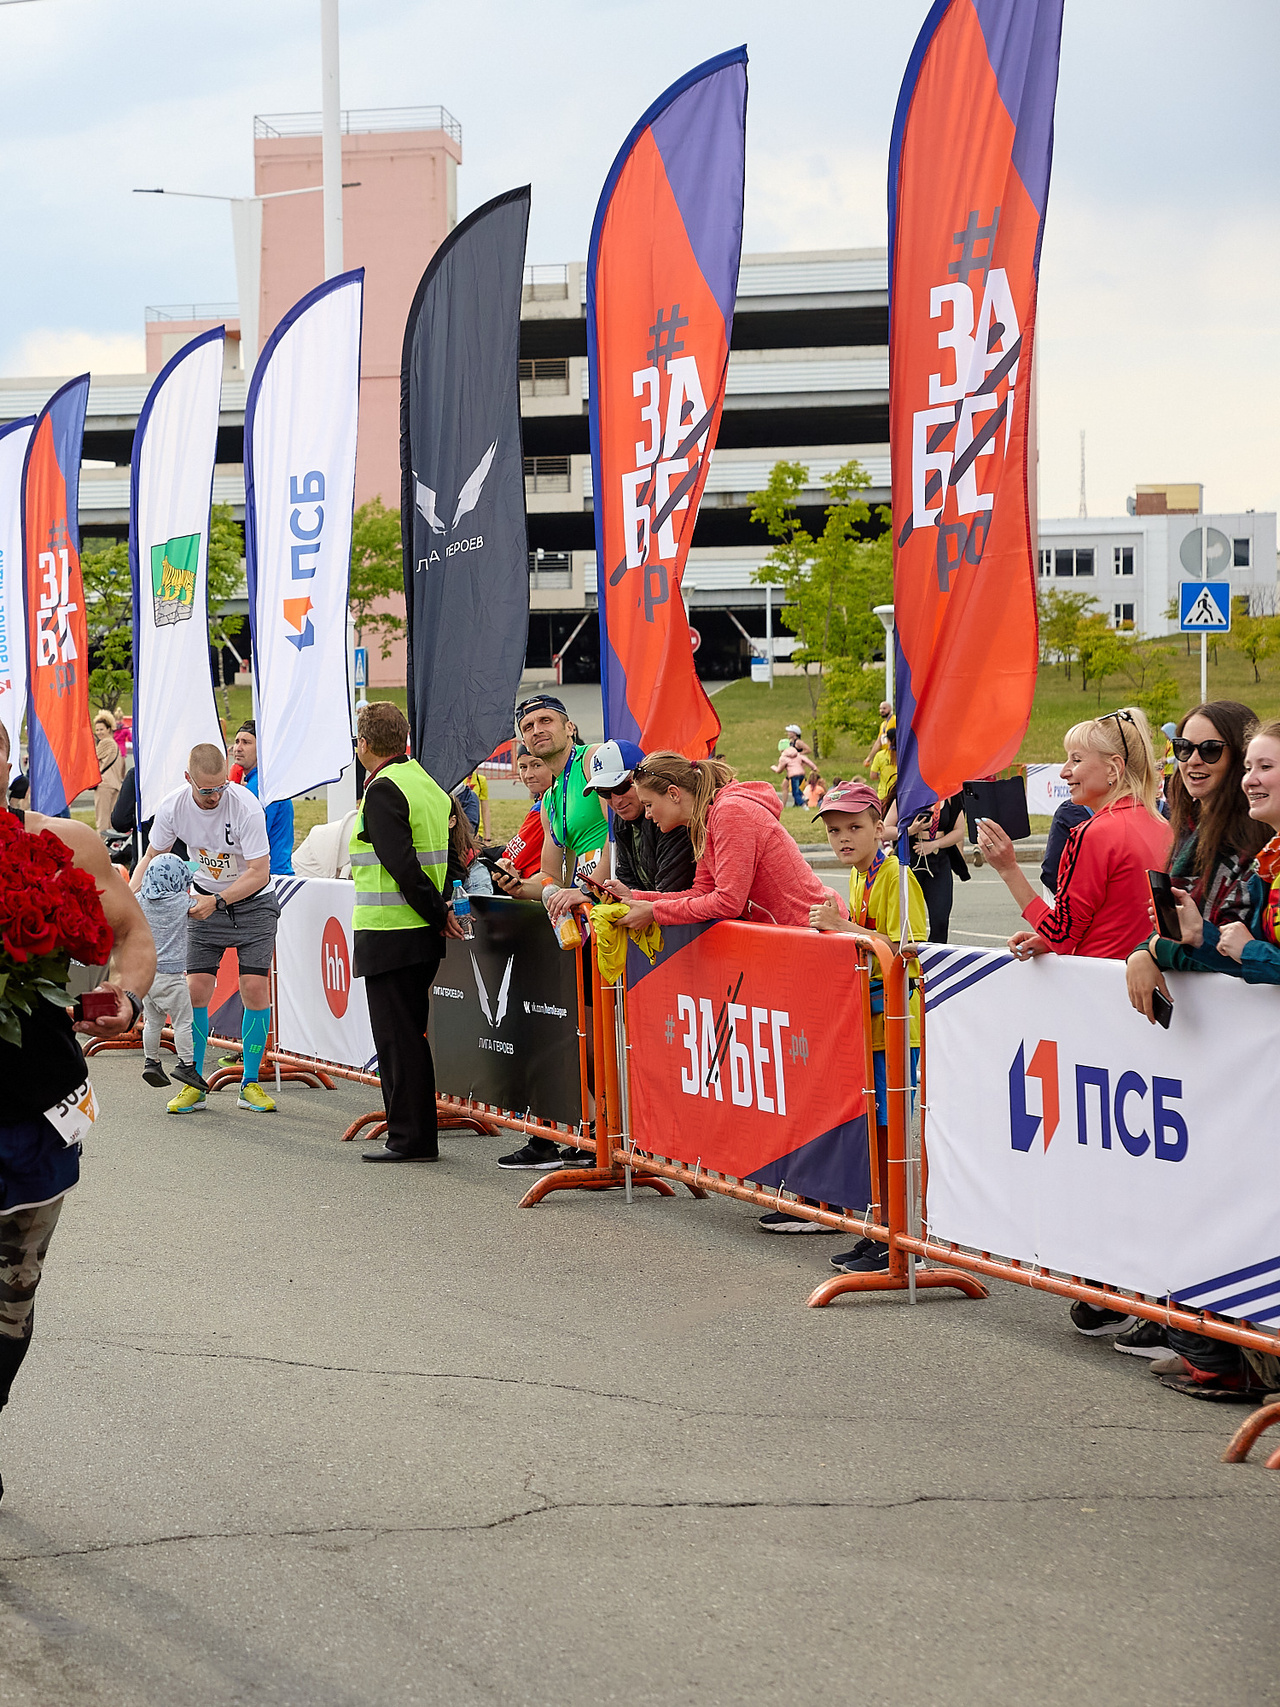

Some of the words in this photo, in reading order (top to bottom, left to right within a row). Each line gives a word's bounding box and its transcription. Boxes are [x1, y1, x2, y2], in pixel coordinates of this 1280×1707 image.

[290, 470, 325, 580] ПСБ
[622, 452, 712, 569] БЕ
[445, 535, 485, 558] ГЕРОЕВ
[199, 854, 230, 868] 30021
[325, 942, 346, 992] hh
[478, 1037, 493, 1051] ЛИГА
[493, 1040, 514, 1055] ГЕРОЕВ
[1075, 1063, 1188, 1162] ПСБ
